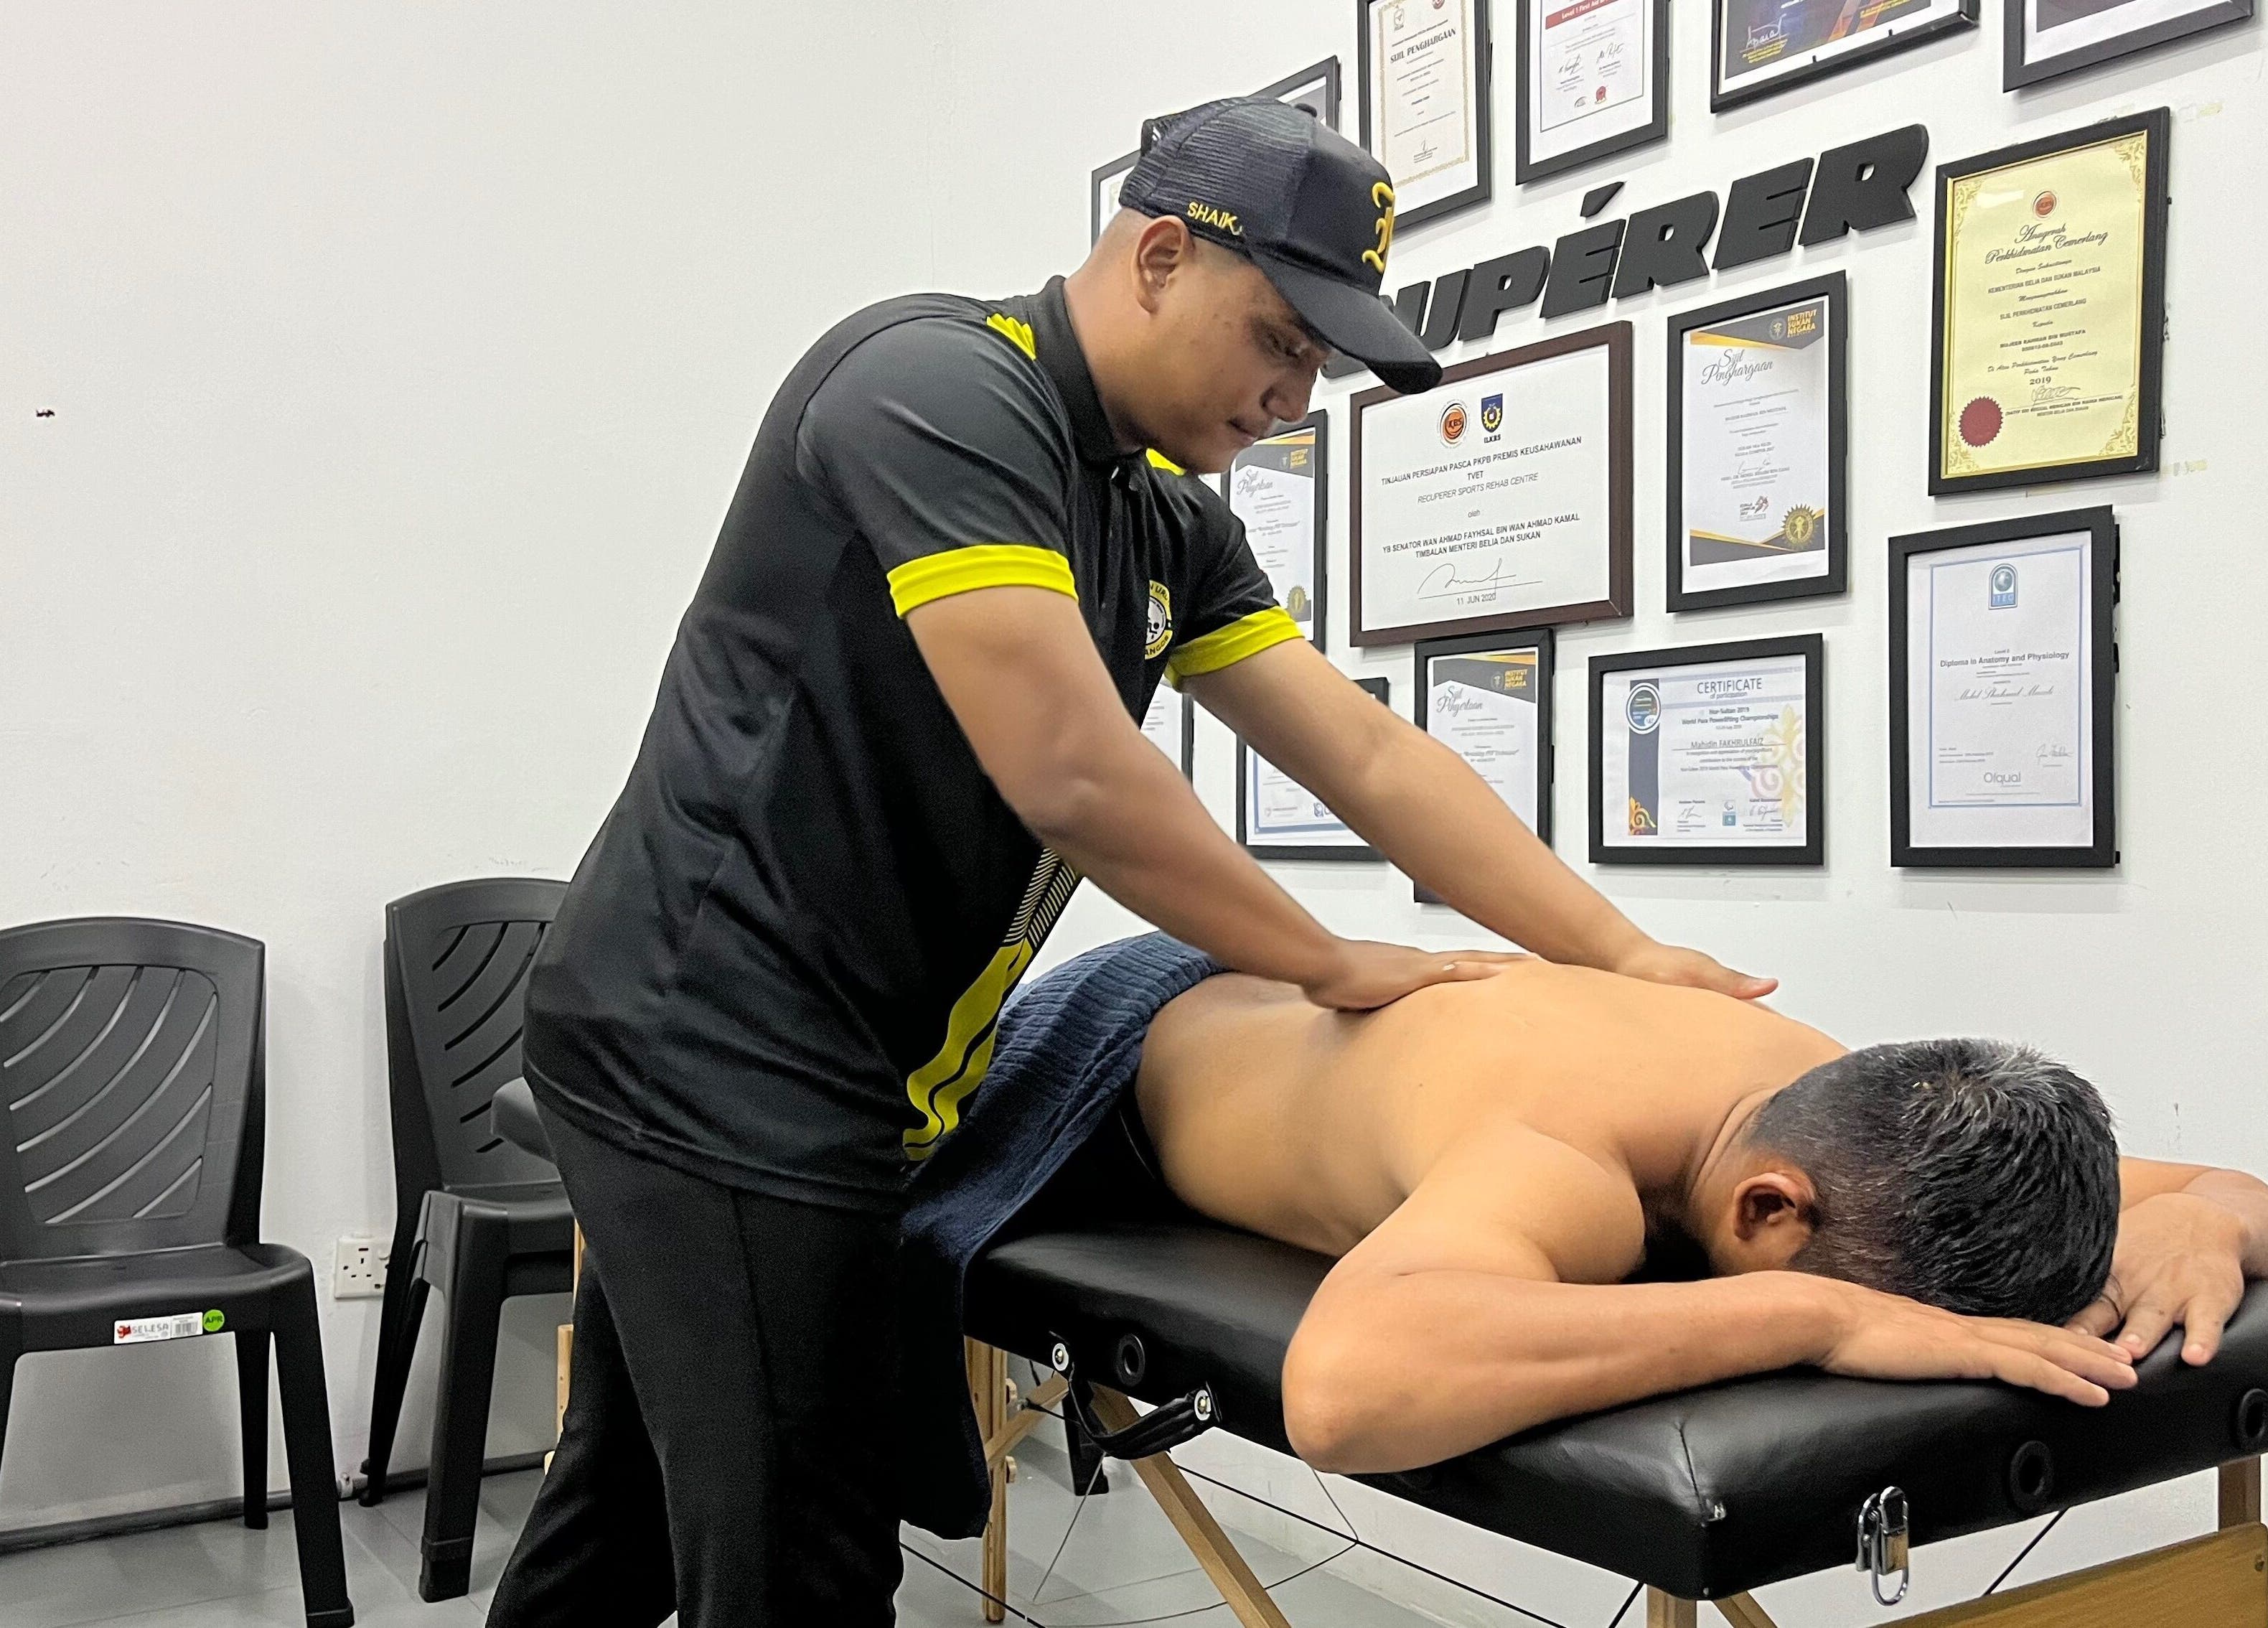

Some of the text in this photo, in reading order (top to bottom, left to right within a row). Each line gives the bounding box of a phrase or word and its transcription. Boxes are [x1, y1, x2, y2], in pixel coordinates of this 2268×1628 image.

[2053, 231, 2109, 248] Cemerlang
[2073, 266, 2101, 277] MALAYSIA
[2029, 376, 2051, 385] 2019
[1381, 473, 1411, 486] TINJAUAN
[1412, 464, 1448, 479] PERSIAPAN
[1449, 459, 1471, 471] PASCA
[1493, 450, 1519, 462] PREMIS
[1520, 436, 1582, 456] KEUSAHAWANAN
[1467, 470, 1484, 480] TVET
[1458, 483, 1484, 496] SPORTS
[1486, 479, 1509, 490] REHAB
[1510, 472, 1540, 485] CENTRE
[1392, 540, 1421, 552] SENATOR
[1423, 537, 1438, 547] WAN
[1439, 533, 1462, 544] AHMAD
[1464, 528, 1494, 540] FAYHSAL
[1496, 525, 1507, 534] BIN
[1509, 523, 1525, 532] WAN
[1527, 518, 1552, 529] AHMAD
[1554, 513, 1580, 524] KAMAL
[1415, 530, 1541, 558] TIMBALAN MENTERI BELIA DAN SUKAN
[1978, 656, 2010, 665] Anatomy
[2027, 652, 2070, 661] Physiology
[1697, 678, 1763, 694] CERTIFICATE
[205, 1315, 223, 1324] APR
[132, 1323, 169, 1334] SELESA
